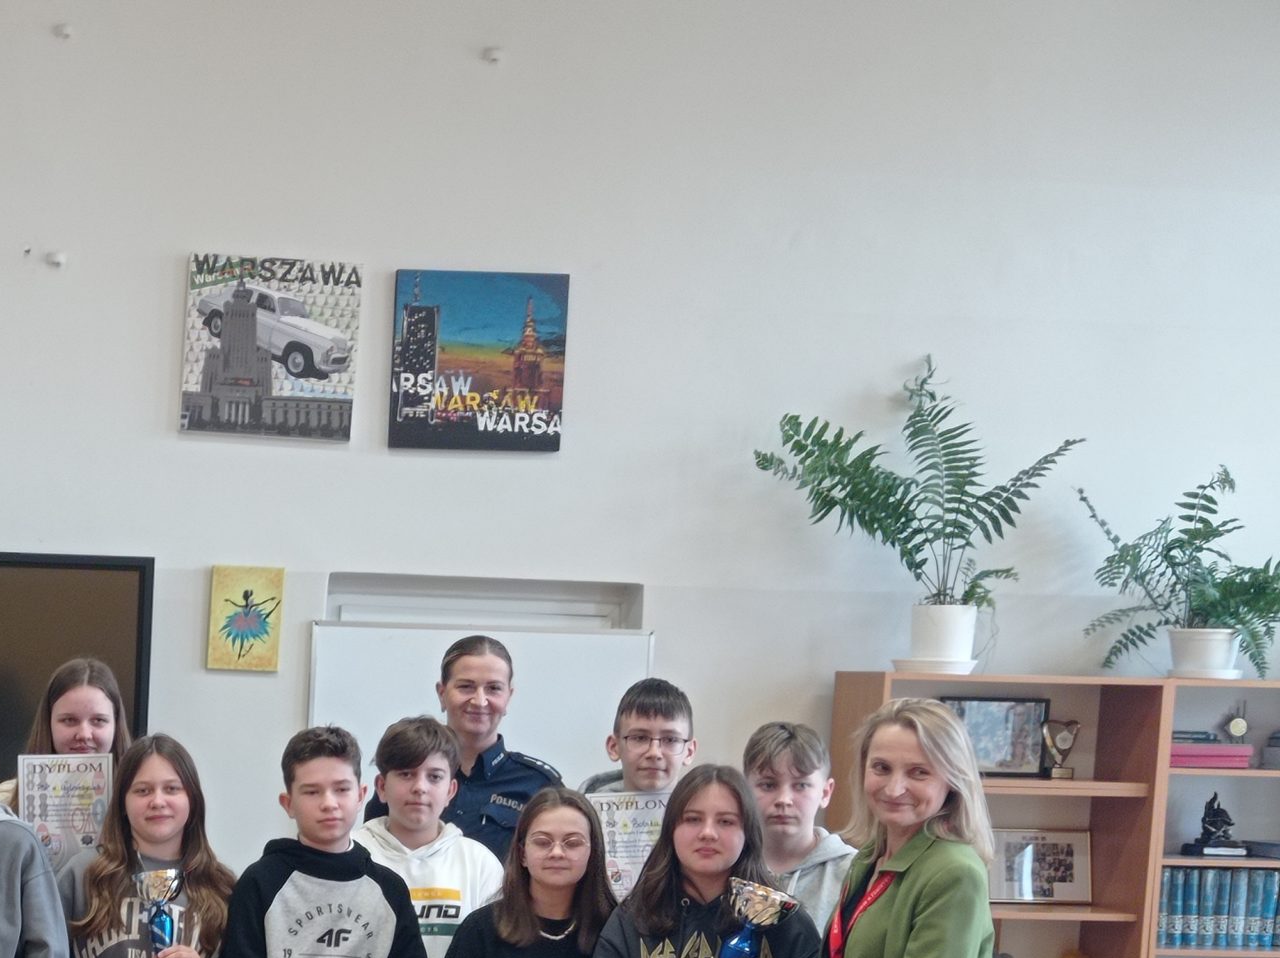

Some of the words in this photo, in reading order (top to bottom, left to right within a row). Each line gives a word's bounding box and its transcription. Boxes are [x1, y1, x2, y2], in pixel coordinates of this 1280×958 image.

[194, 253, 362, 288] WARSZAWA
[33, 763, 102, 774] DYPLOM
[490, 794, 524, 811] POLICJ
[316, 928, 352, 947] 4F
[283, 948, 292, 958] 19
